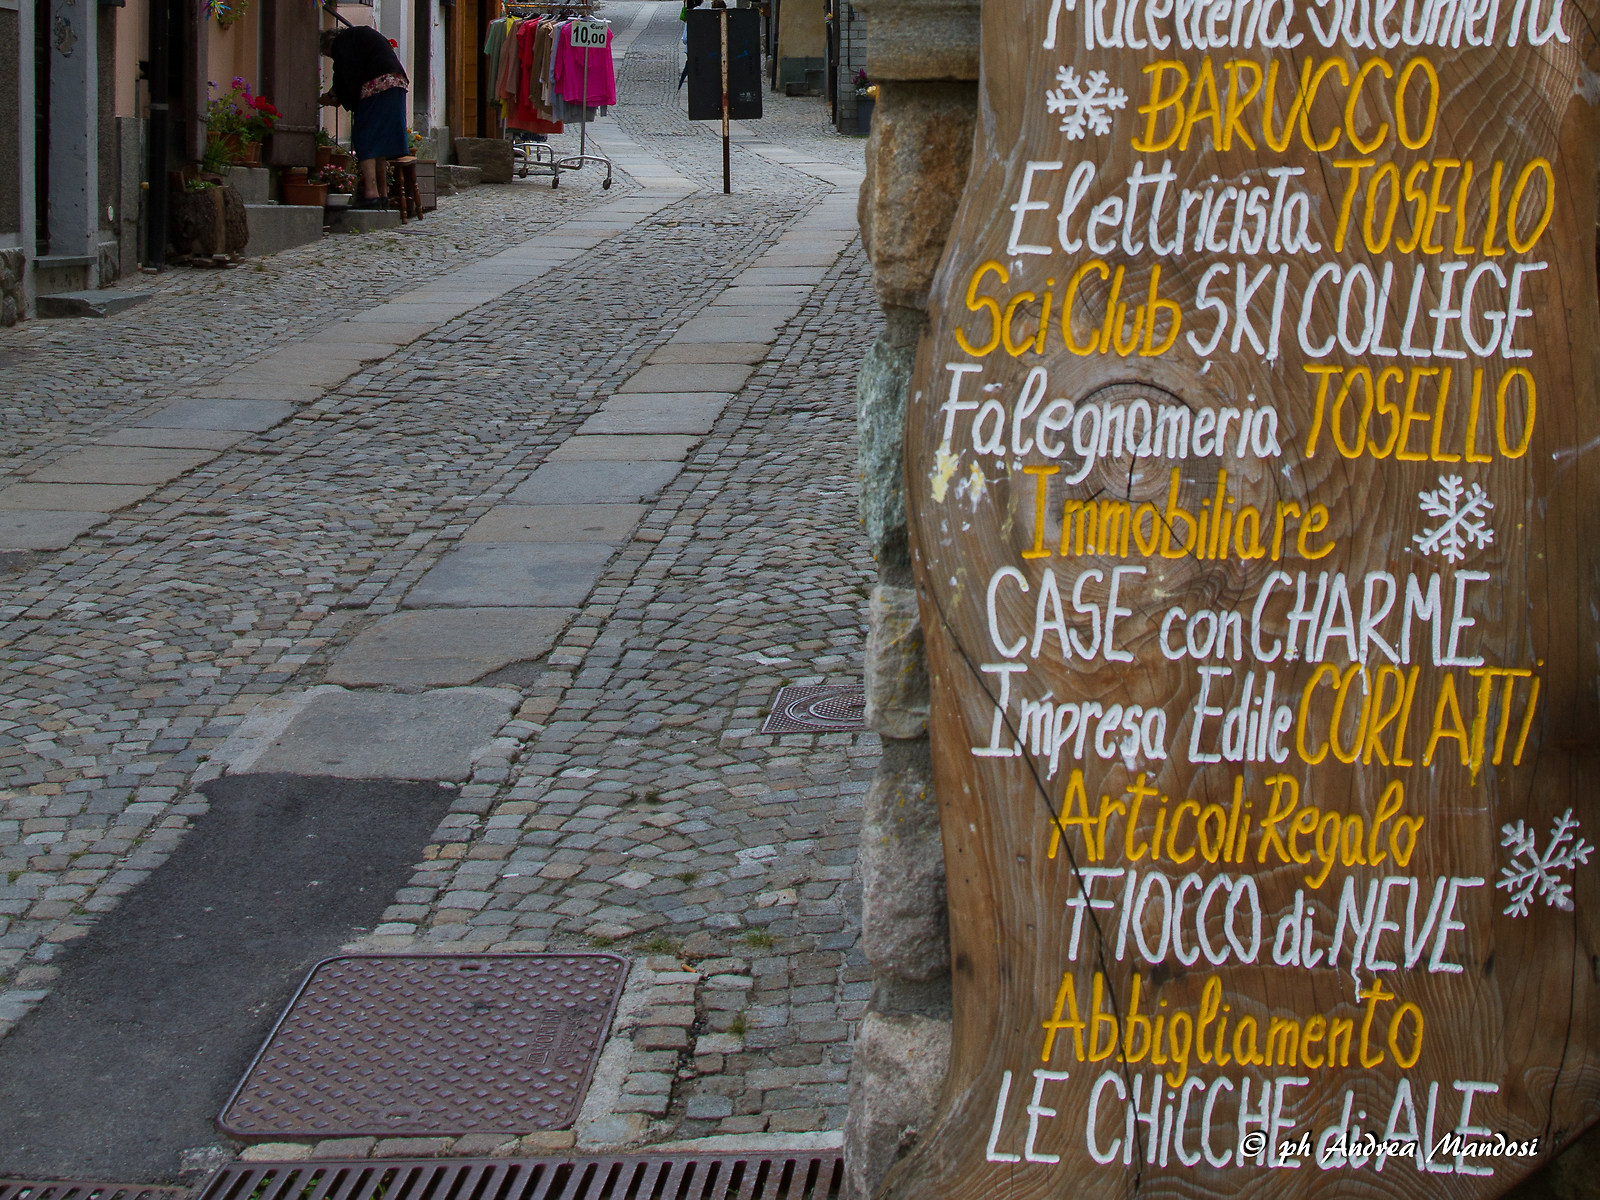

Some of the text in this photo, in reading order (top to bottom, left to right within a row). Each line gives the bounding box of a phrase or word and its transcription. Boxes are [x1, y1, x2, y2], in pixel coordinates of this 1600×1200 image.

[573, 26, 606, 46] 10,00
[1131, 55, 1440, 154] BARUCCO
[1007, 157, 1556, 257] Elettricista TOSELLO
[954, 259, 1549, 361] Sci Club SKI COLLEGE
[943, 362, 1537, 485] Falegnameria TOSELLO
[1021, 464, 1336, 562] Immobiliare
[986, 565, 1492, 668] CASE con CHARME
[971, 662, 1167, 780] Impresa
[1188, 666, 1292, 763] Edile
[1048, 768, 1424, 890] Articoli Regalo
[1065, 867, 1486, 974] FIOCCO di NEVE
[1041, 971, 1424, 1088] Abbigliamento
[986, 1071, 1069, 1163] LE
[1375, 1077, 1499, 1176] ALE
